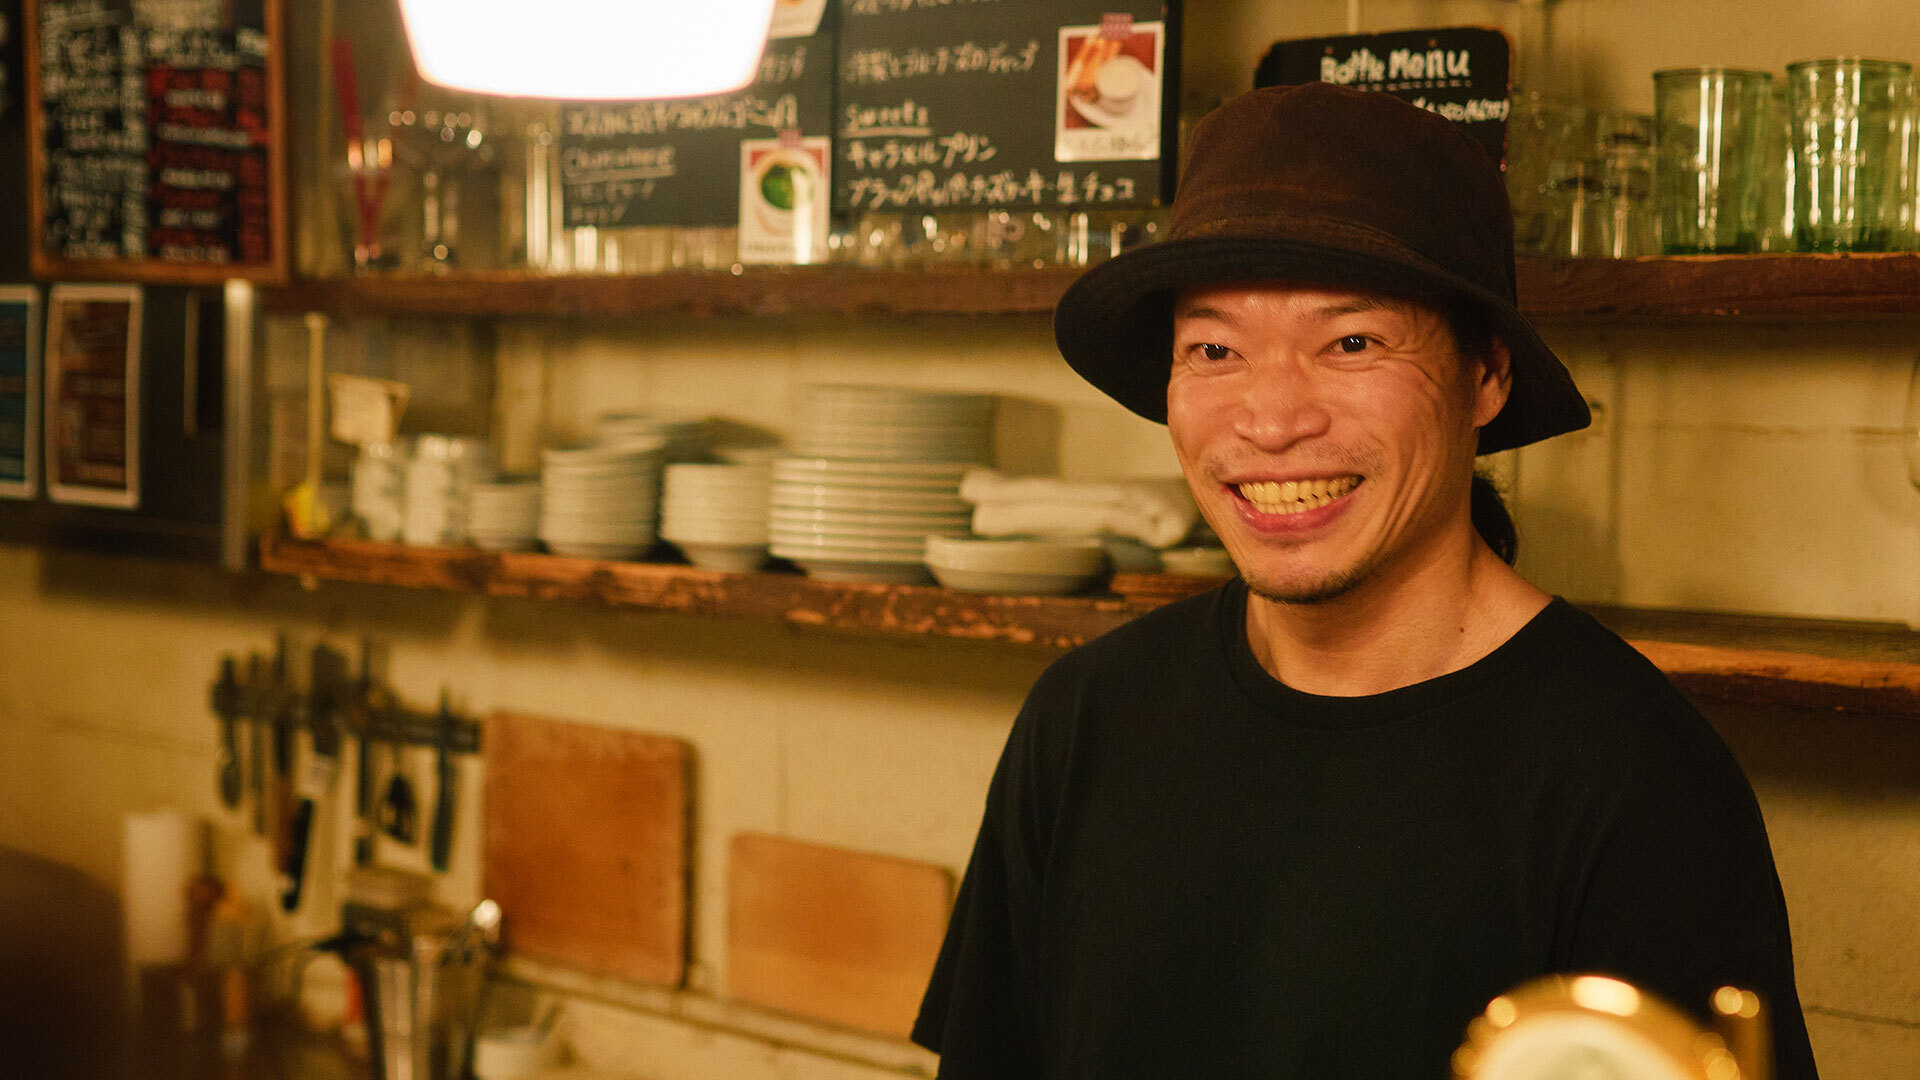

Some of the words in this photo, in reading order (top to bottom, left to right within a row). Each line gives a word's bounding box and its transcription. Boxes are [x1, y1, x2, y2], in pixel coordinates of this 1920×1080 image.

[1320, 48, 1386, 83] Bottle
[1389, 48, 1471, 80] Menu
[844, 99, 929, 129] Sweets
[846, 131, 997, 169] キャラメルプリン
